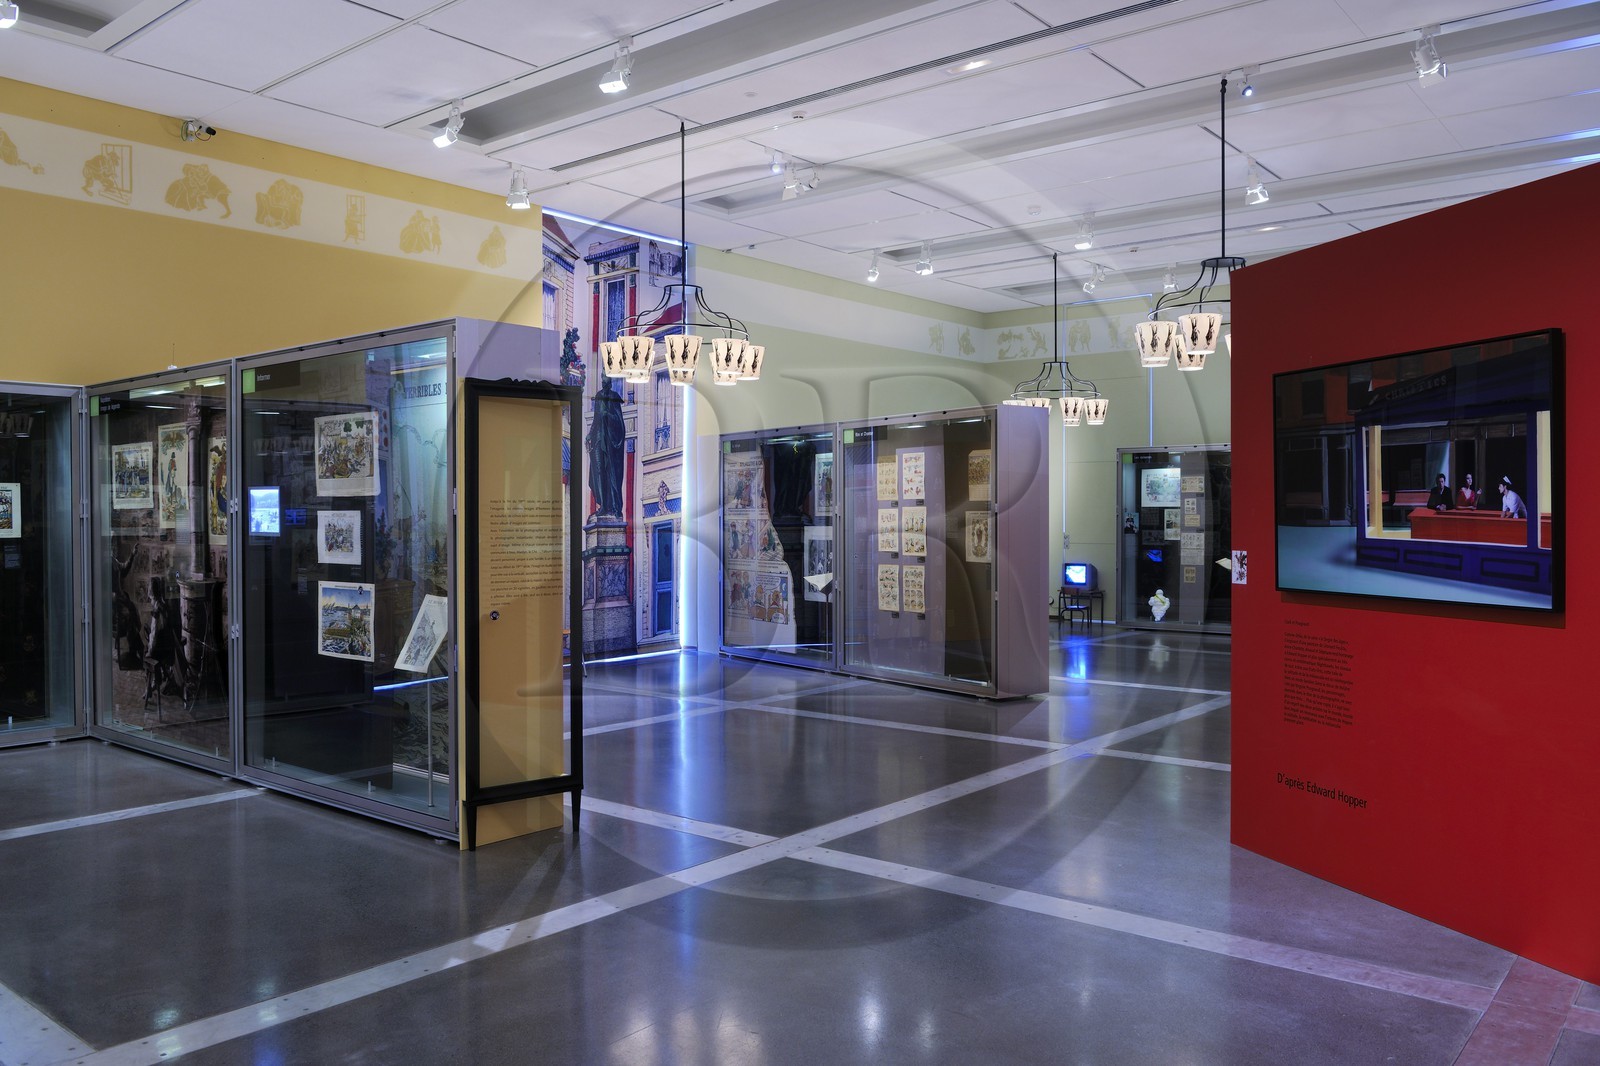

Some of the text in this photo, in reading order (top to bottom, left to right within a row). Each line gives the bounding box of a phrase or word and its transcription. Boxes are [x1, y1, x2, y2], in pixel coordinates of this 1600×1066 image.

[1277, 773, 1367, 809] D'après Edward Hopper
